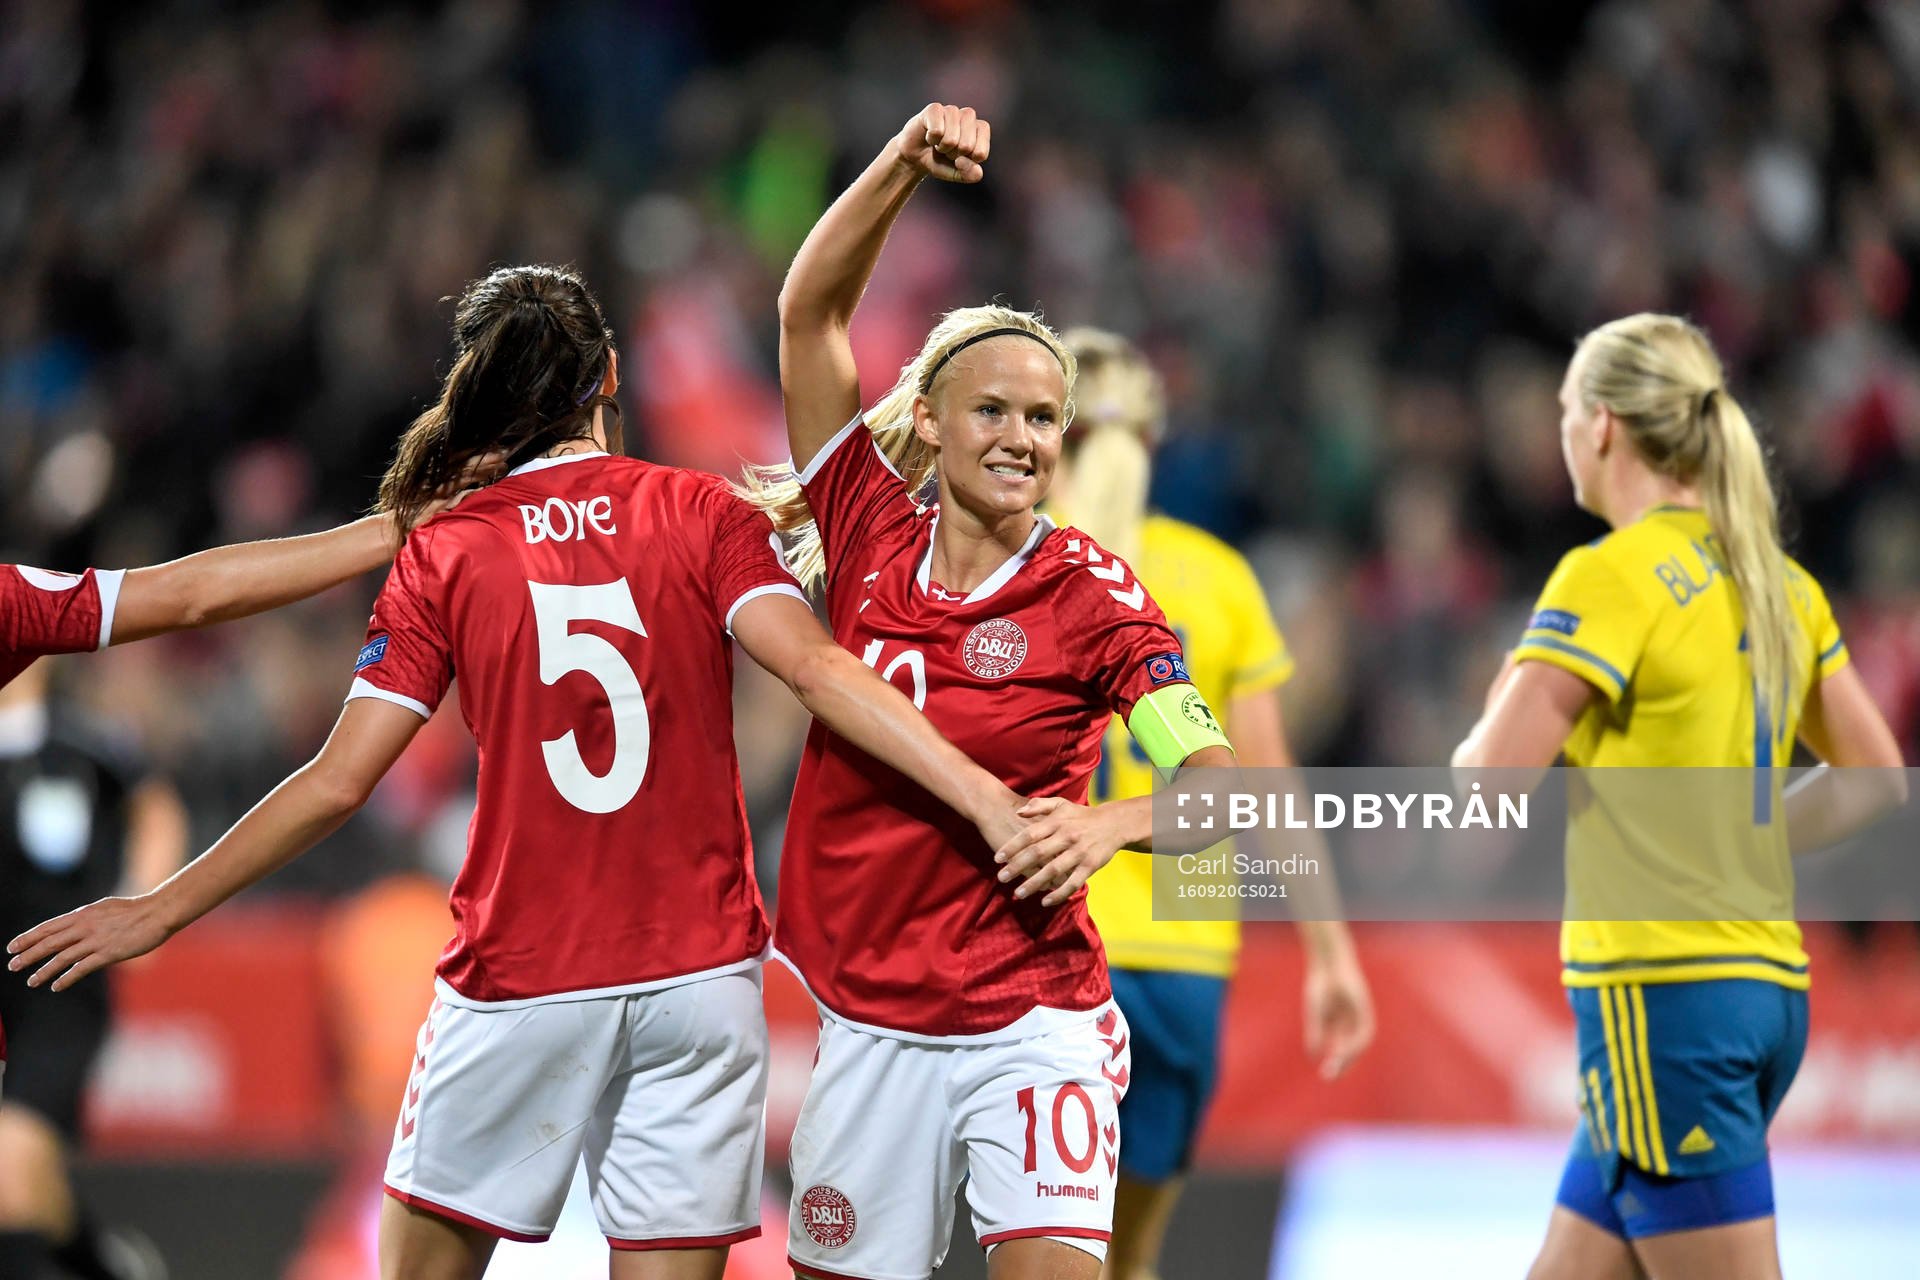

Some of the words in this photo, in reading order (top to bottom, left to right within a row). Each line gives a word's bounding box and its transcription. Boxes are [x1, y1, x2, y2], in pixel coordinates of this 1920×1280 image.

[518, 495, 618, 544] BOYE
[975, 637, 1015, 660] DBU
[528, 576, 651, 814] 5
[1017, 1082, 1098, 1174] 10
[1036, 1181, 1099, 1201] hummel
[810, 1205, 845, 1226] DBU
